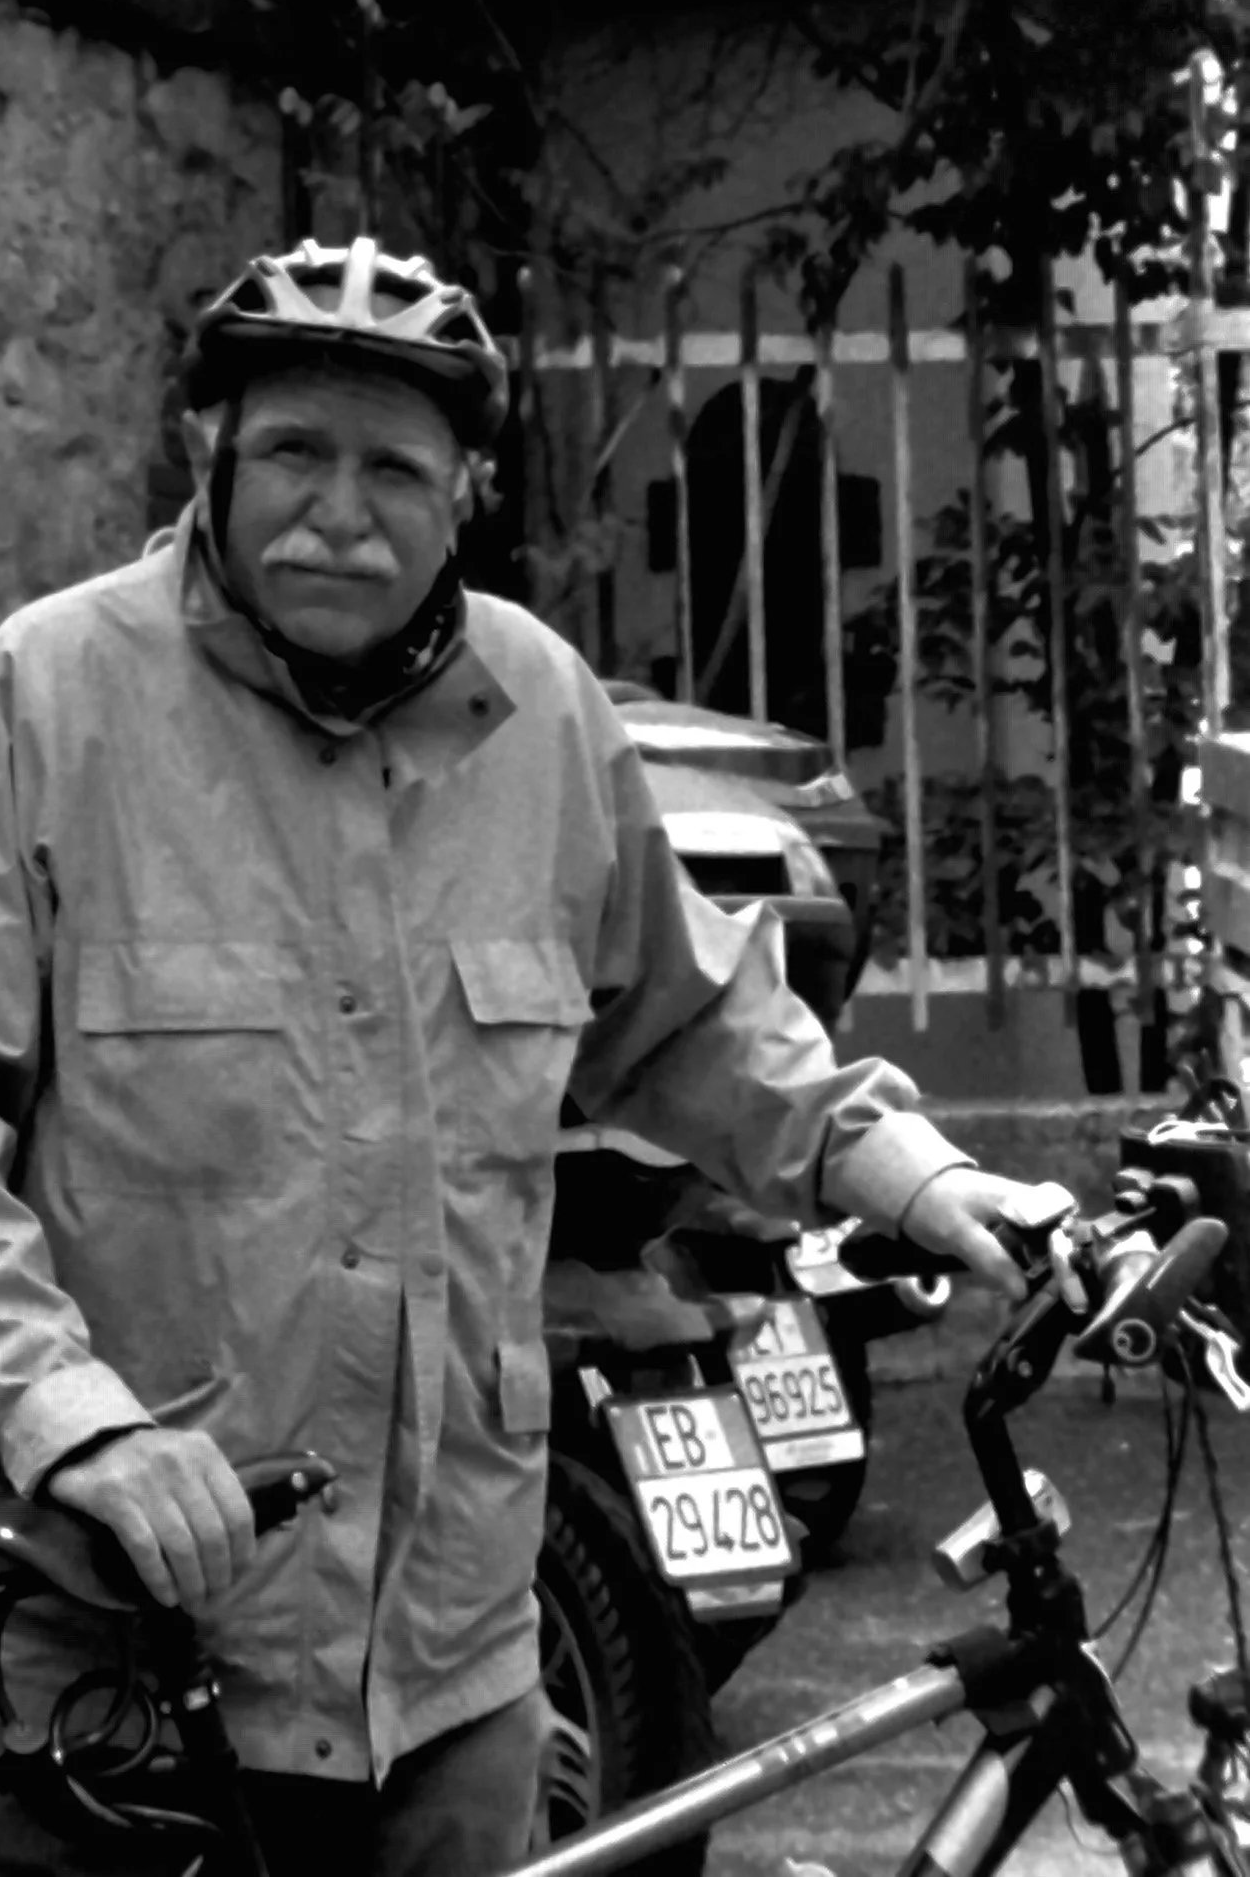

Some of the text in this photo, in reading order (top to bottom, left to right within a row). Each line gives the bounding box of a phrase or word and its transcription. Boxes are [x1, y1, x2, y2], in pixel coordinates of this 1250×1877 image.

[745, 1364, 843, 1424] 96925
[644, 1402, 707, 1470] EB
[650, 1483, 782, 1561] 29428
